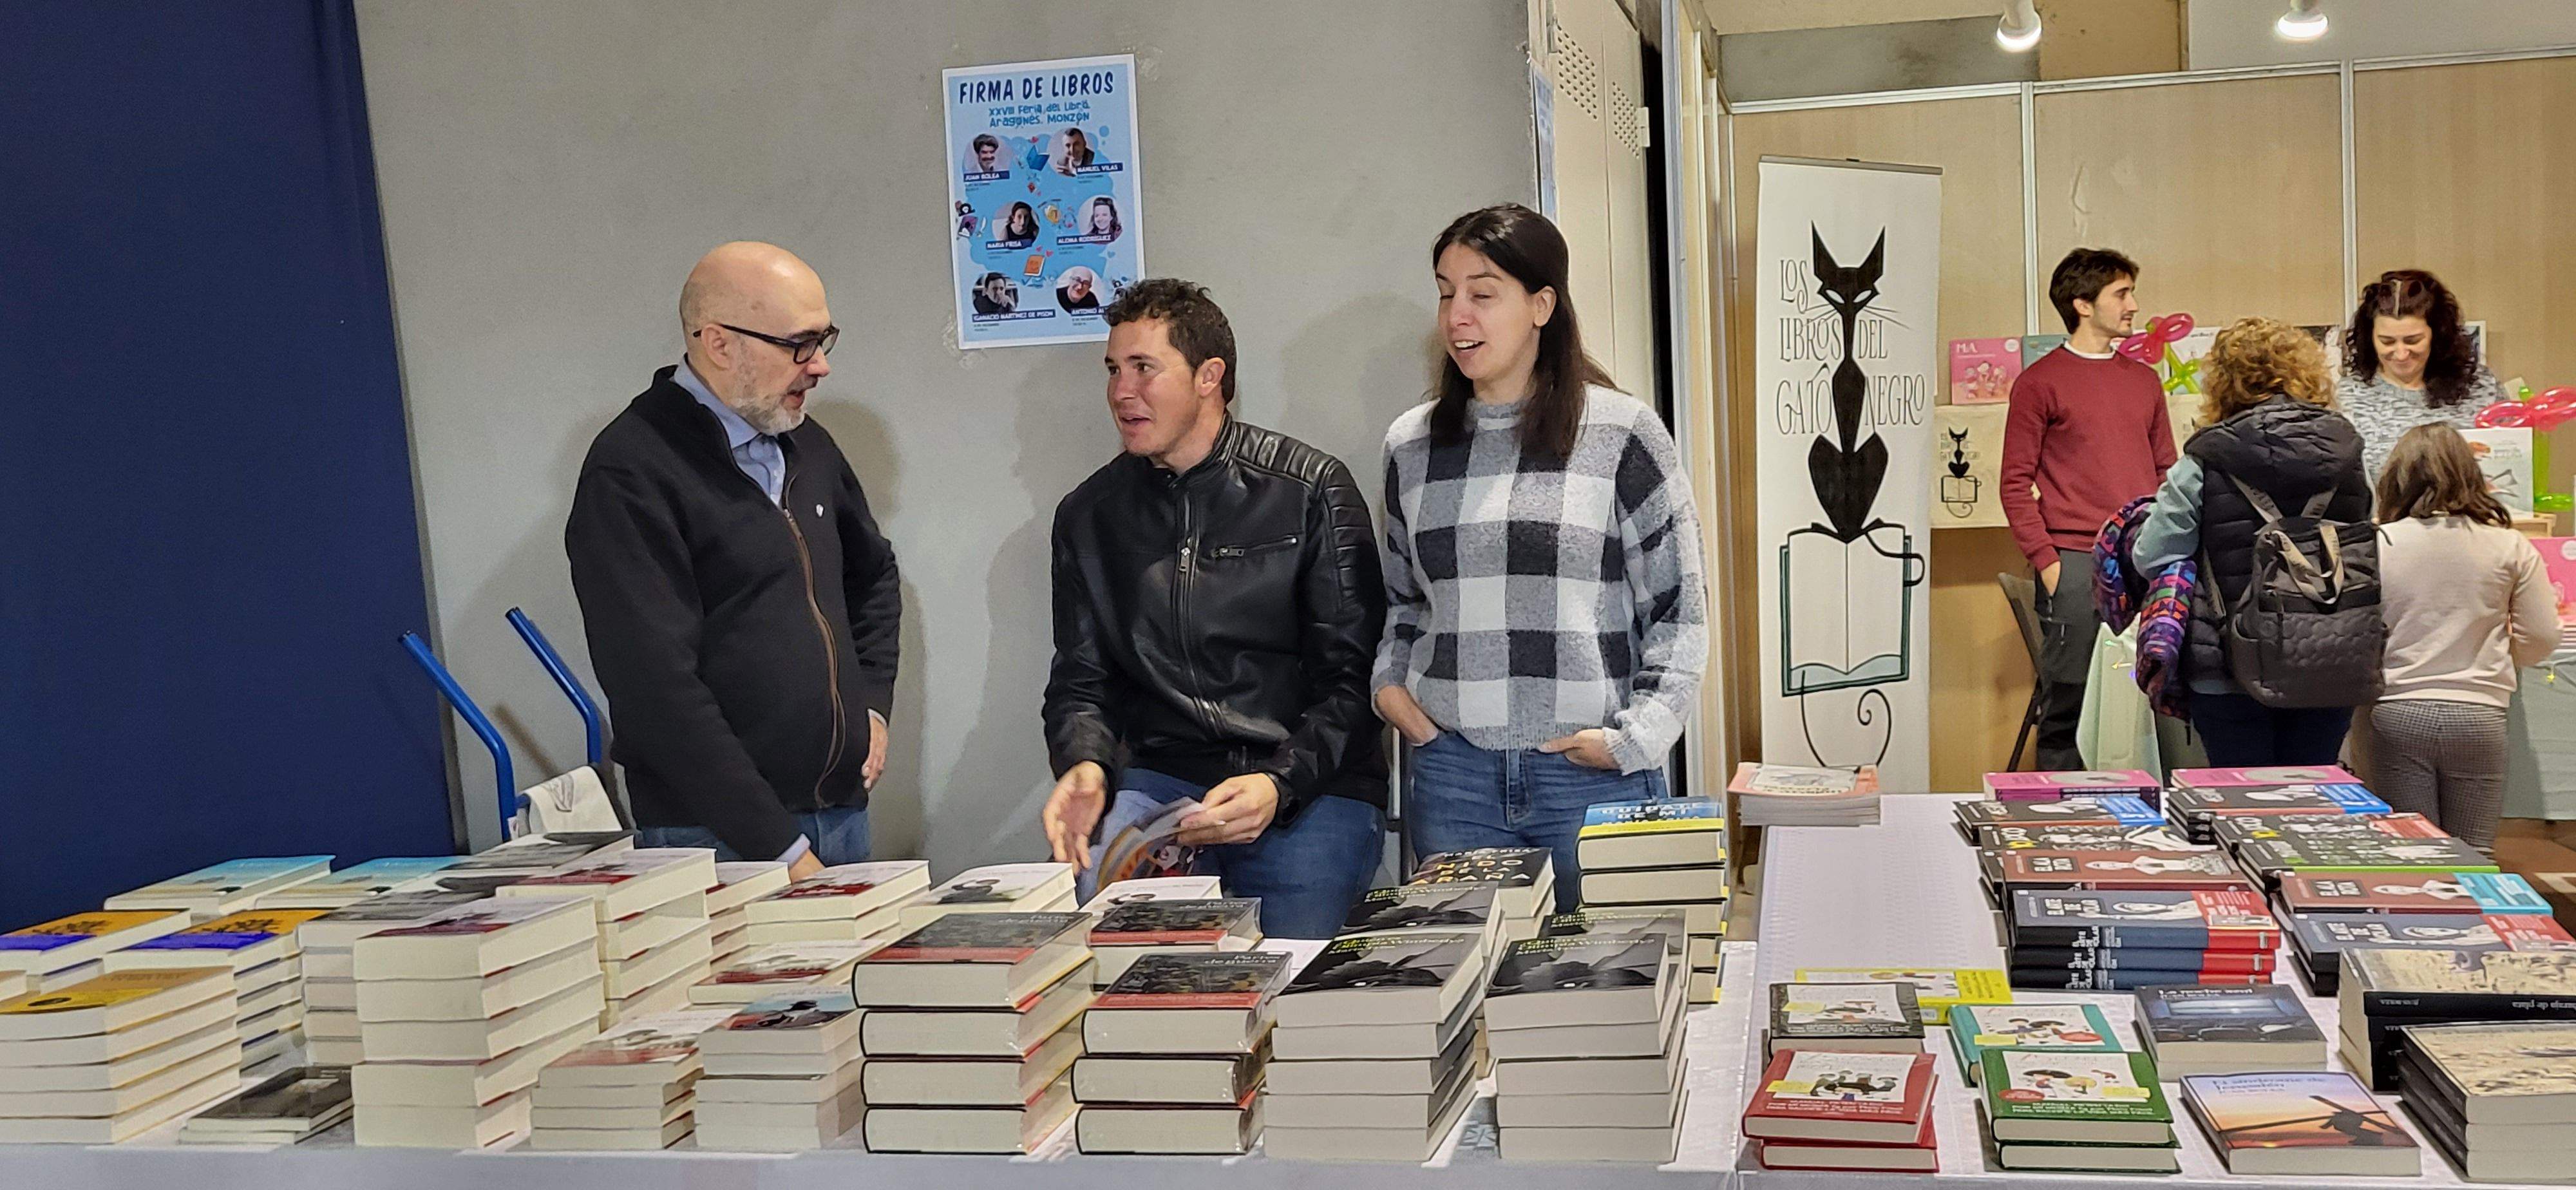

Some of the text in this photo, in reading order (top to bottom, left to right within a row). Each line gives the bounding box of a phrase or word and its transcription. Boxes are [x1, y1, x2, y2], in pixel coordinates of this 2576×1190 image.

[959, 71, 1114, 104] FIRMA DE LIBROS
[1018, 104, 1043, 115] Feria
[1045, 103, 1061, 113] del
[1779, 259, 1809, 314] LOS
[1779, 317, 1889, 362] LIBROS DEL
[1865, 373, 1926, 427] NEGRO
[1436, 860, 1524, 870] NIDO
